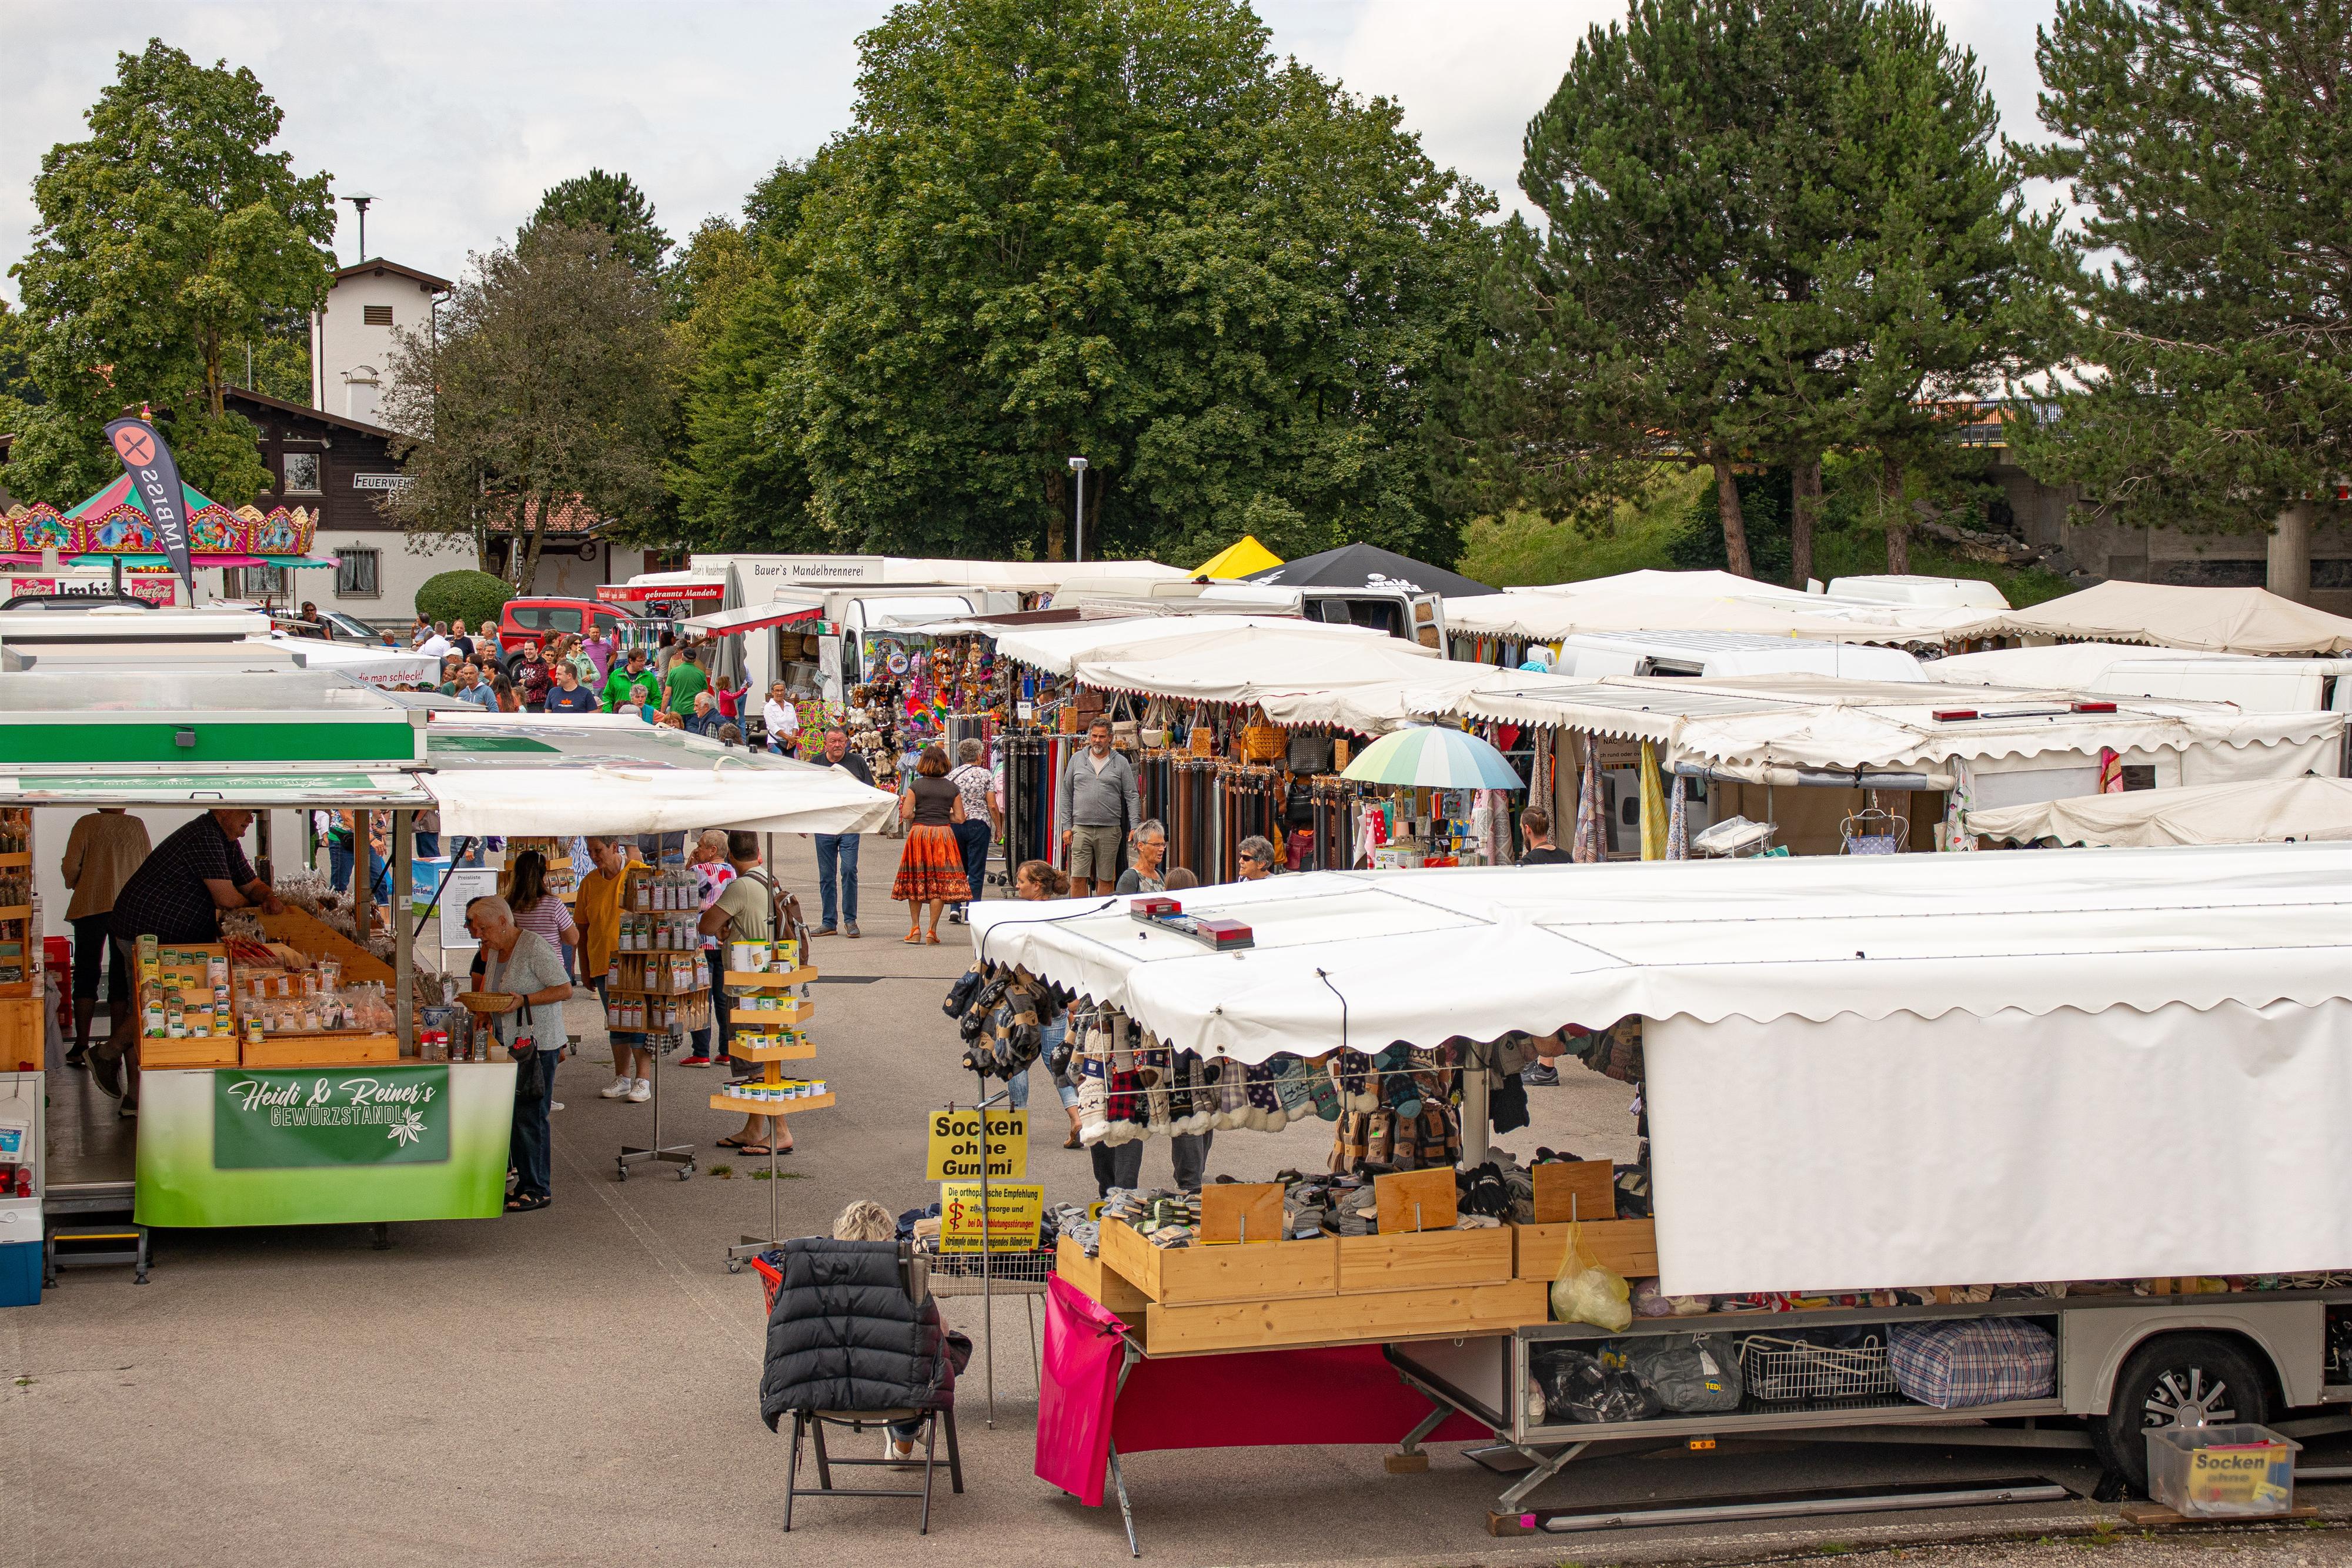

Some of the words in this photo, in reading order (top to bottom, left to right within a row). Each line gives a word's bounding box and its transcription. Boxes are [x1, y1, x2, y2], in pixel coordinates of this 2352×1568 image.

[793, 564, 864, 576] Mandelbrennerei
[645, 590, 682, 600] gebrannte
[685, 589, 717, 597] Mandeln
[389, 669, 423, 682] schleckt!
[228, 1081, 301, 1111] Heidi
[306, 1078, 331, 1106] &
[271, 1104, 405, 1126] GEWÜRZSTANDL
[936, 1116, 1023, 1137] Socken
[948, 1188, 958, 1196] Die
[1004, 1189, 1038, 1201] Empfehlung
[985, 1205, 1010, 1214] orsorge
[944, 1236, 966, 1247] Strümpfe
[967, 1238, 979, 1246] ohne
[1705, 1382, 1721, 1391] TEDi
[2196, 1454, 2265, 1469] Socken
